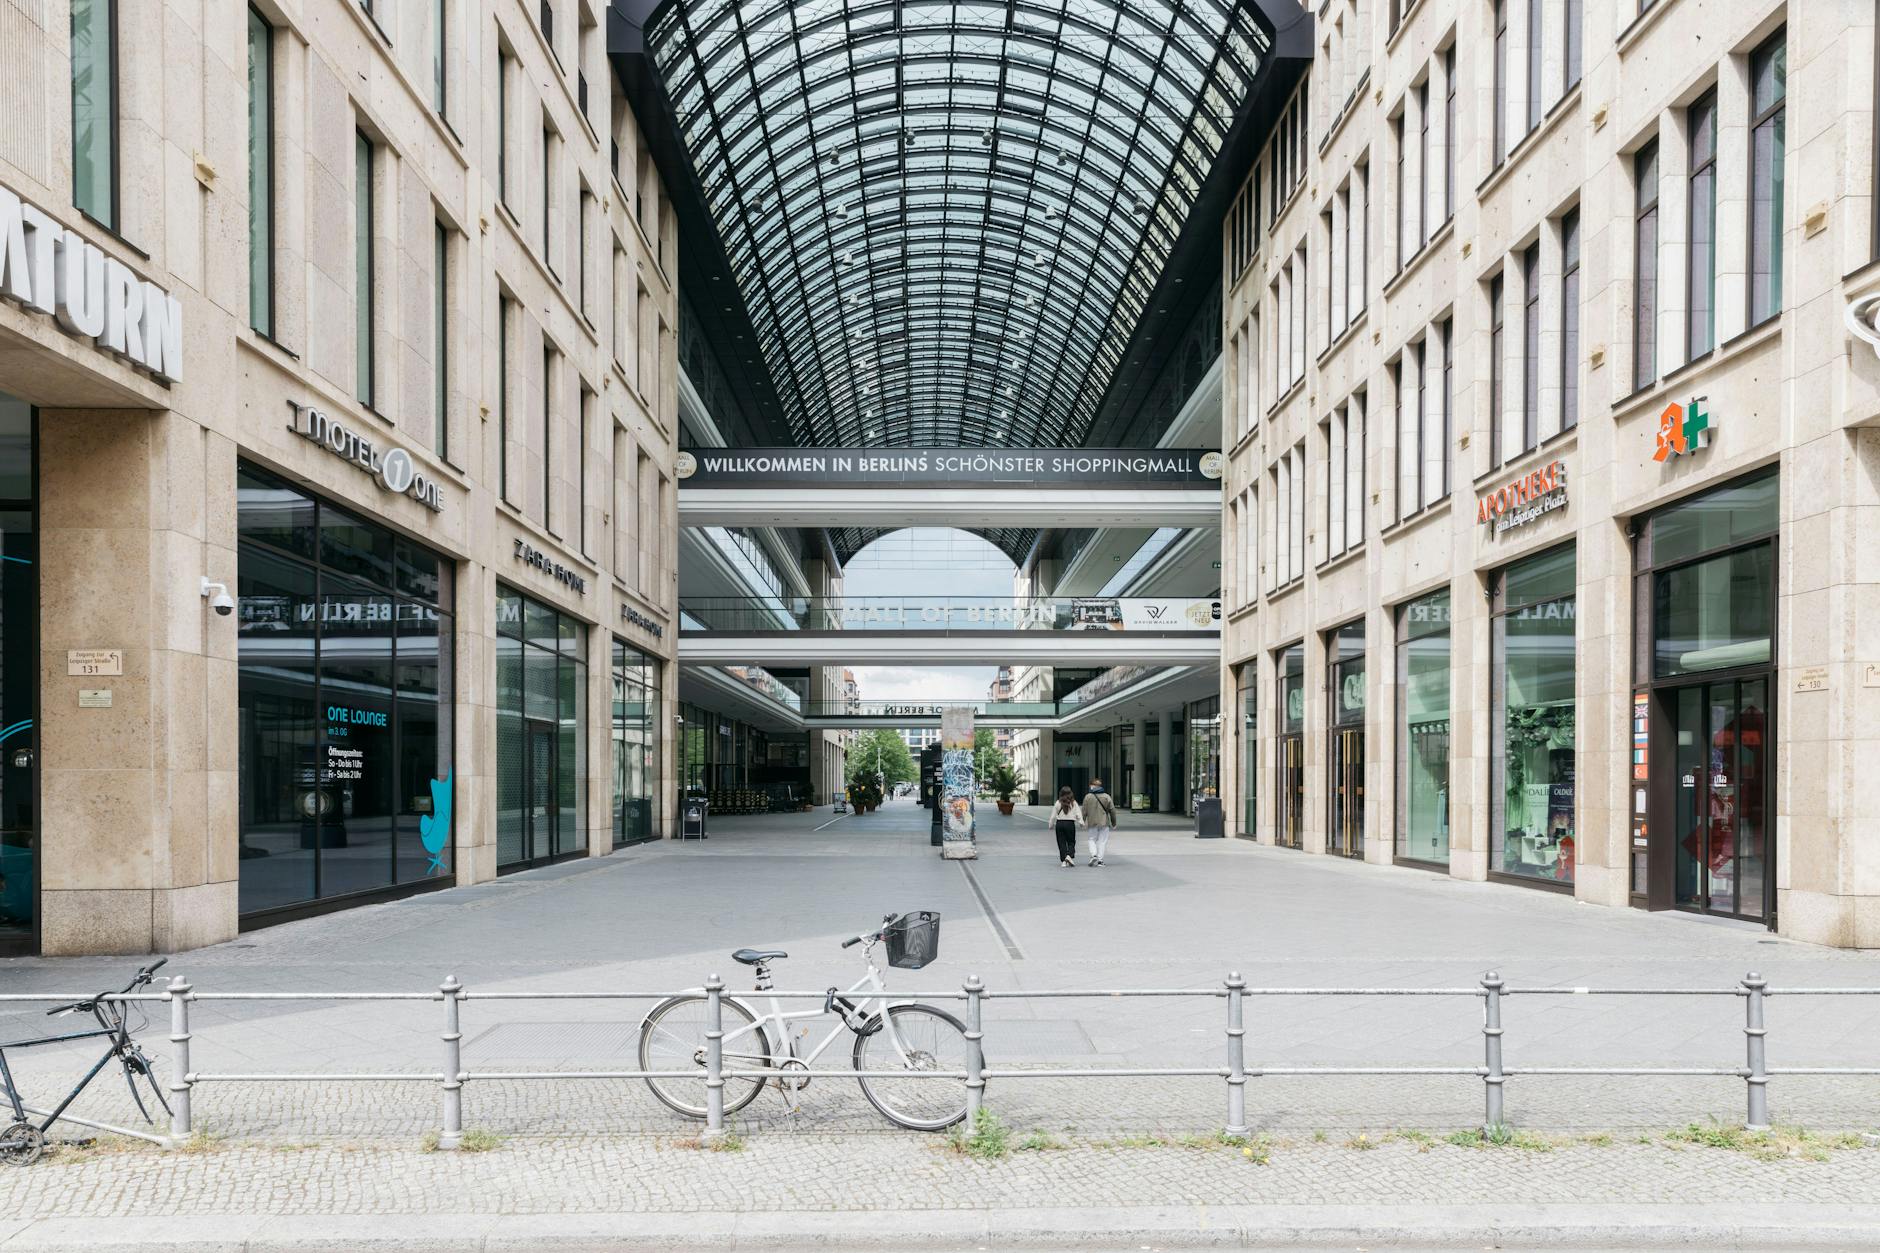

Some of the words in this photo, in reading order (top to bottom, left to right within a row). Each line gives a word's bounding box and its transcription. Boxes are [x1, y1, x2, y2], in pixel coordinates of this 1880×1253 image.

[306, 406, 380, 474] MOTEL
[414, 472, 445, 512] ONE
[703, 457, 826, 473] WILLKOMMEN
[832, 457, 852, 473] IN
[858, 457, 928, 472] BERLINS
[935, 454, 1045, 472] SCHÖNSTER
[1051, 457, 1193, 473] SHOPPINGMALL
[1476, 460, 1562, 526] APOTHEKE
[1509, 504, 1544, 527] Leipziger
[1544, 493, 1567, 512] Platz
[513, 537, 553, 576] ZARA
[554, 563, 587, 597] HOME
[621, 603, 644, 629] ZARA
[841, 605, 909, 622] MALL
[919, 605, 953, 622] OF
[82, 665, 98, 674] 131
[1809, 680, 1821, 689] 130
[327, 706, 348, 723] ONE
[350, 708, 387, 727] LOUNGE
